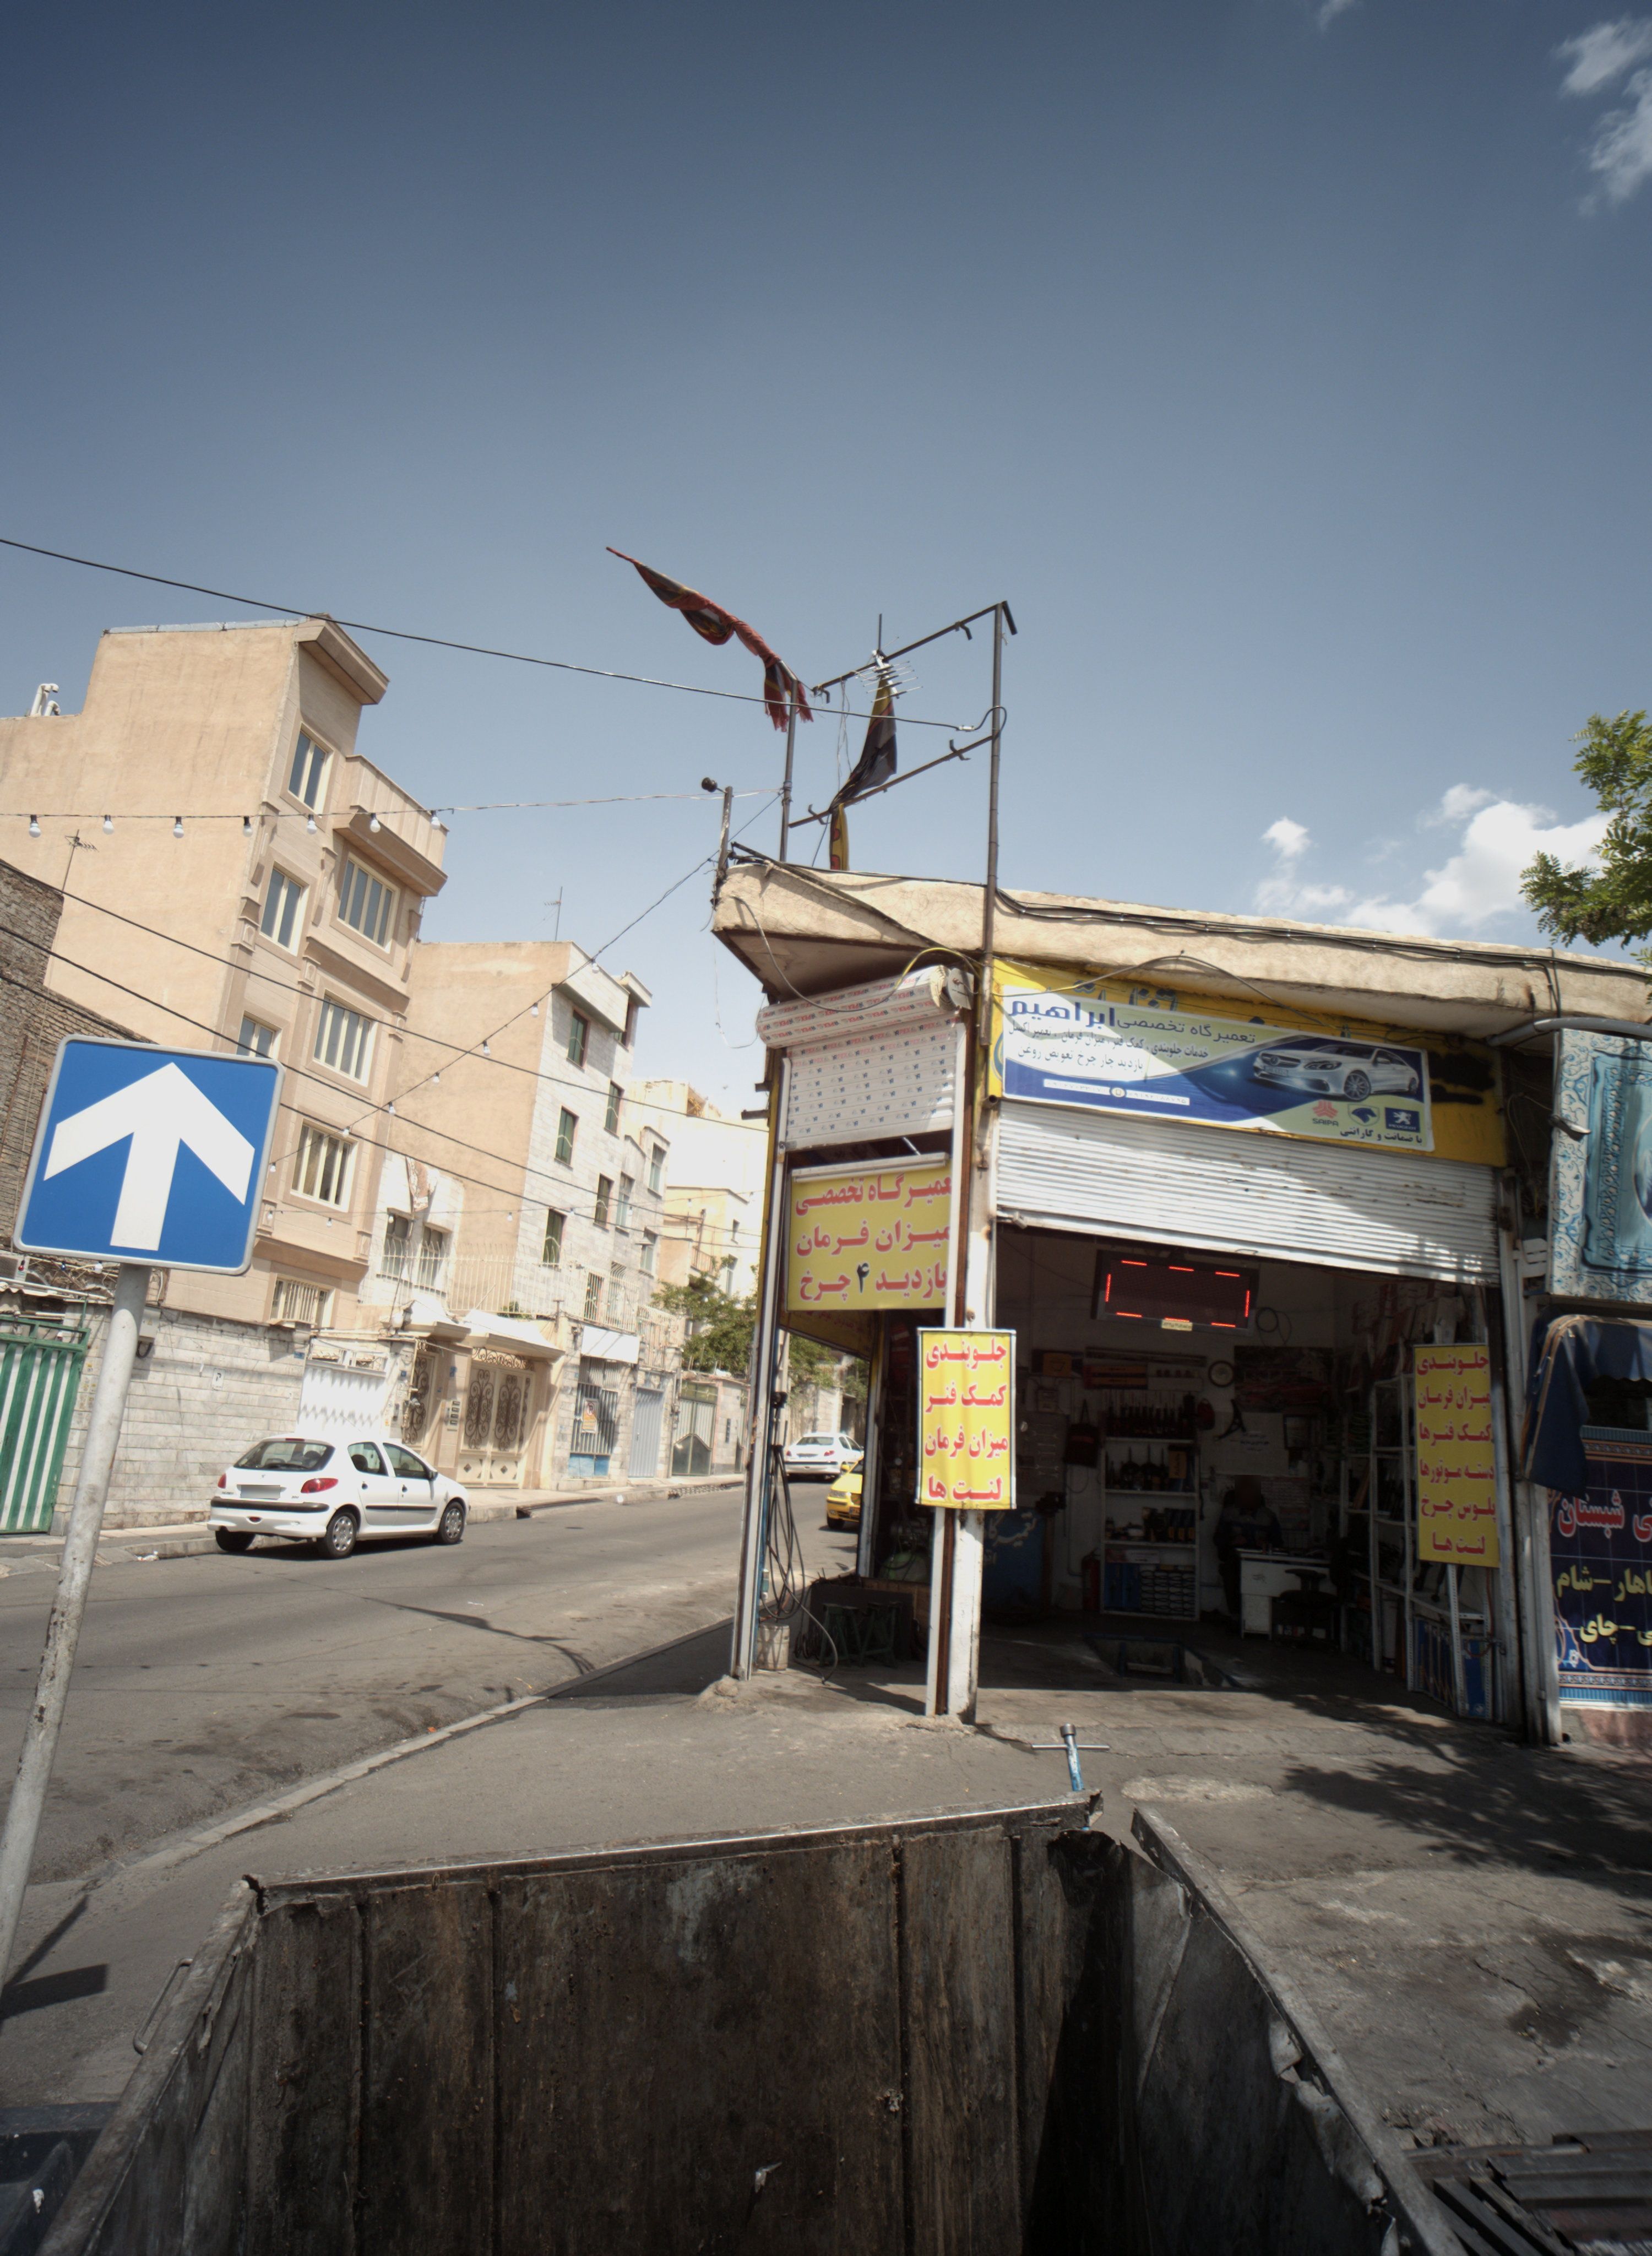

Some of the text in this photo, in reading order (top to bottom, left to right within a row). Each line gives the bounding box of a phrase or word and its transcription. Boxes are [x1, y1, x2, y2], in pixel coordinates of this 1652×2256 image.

[1008, 1000, 1115, 1029] ابراهیم
[1117, 1019, 1184, 1033] تخصصی
[796, 1178, 864, 1216] تخصصی
[796, 1221, 870, 1256] فرمان
[800, 1270, 851, 1301] چرخ
[857, 1262, 870, 1293] ۴
[926, 1337, 1007, 1369] جلوبندی
[1417, 1351, 1489, 1375] جلوبندی
[926, 1381, 1007, 1412] کمک فنر
[1418, 1384, 1491, 1410] میزان فرمان
[925, 1425, 1008, 1458] میزان فرمان
[1458, 1423, 1491, 1441] کمک
[1464, 1463, 1495, 1479] دسته
[928, 1476, 1002, 1500] لنت ها
[1421, 1494, 1497, 1523] پلوس چرخ
[1558, 1489, 1625, 1539] شبستان
[1457, 1536, 1485, 1554] لنت
